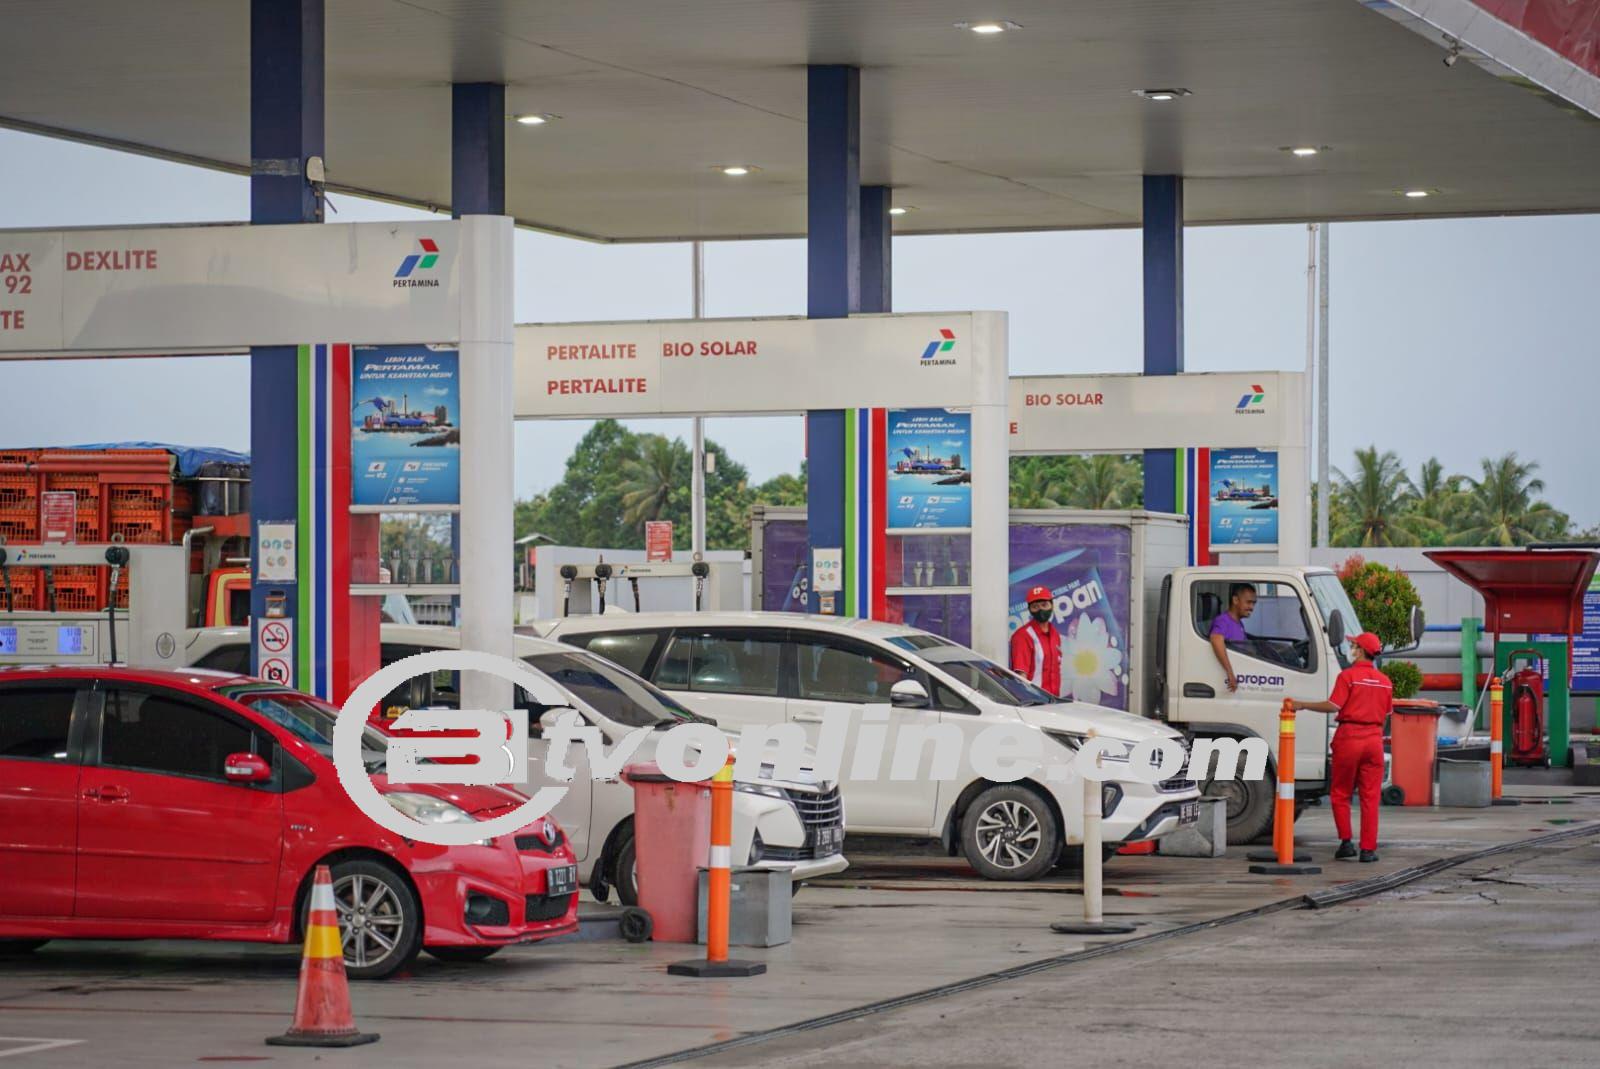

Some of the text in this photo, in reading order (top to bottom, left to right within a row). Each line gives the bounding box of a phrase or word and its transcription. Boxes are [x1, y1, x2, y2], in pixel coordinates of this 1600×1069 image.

[66, 249, 158, 271] DEXLITE
[5, 275, 32, 294] 92
[393, 279, 440, 288] PERTAMINA
[547, 344, 637, 360] PERTALITE
[662, 341, 758, 357] BIO SOLAR
[364, 363, 441, 371] PERTAMAX
[547, 378, 647, 395] PERTALITE
[1025, 393, 1104, 406] BIO SOLAR
[1236, 674, 1285, 686] propan
